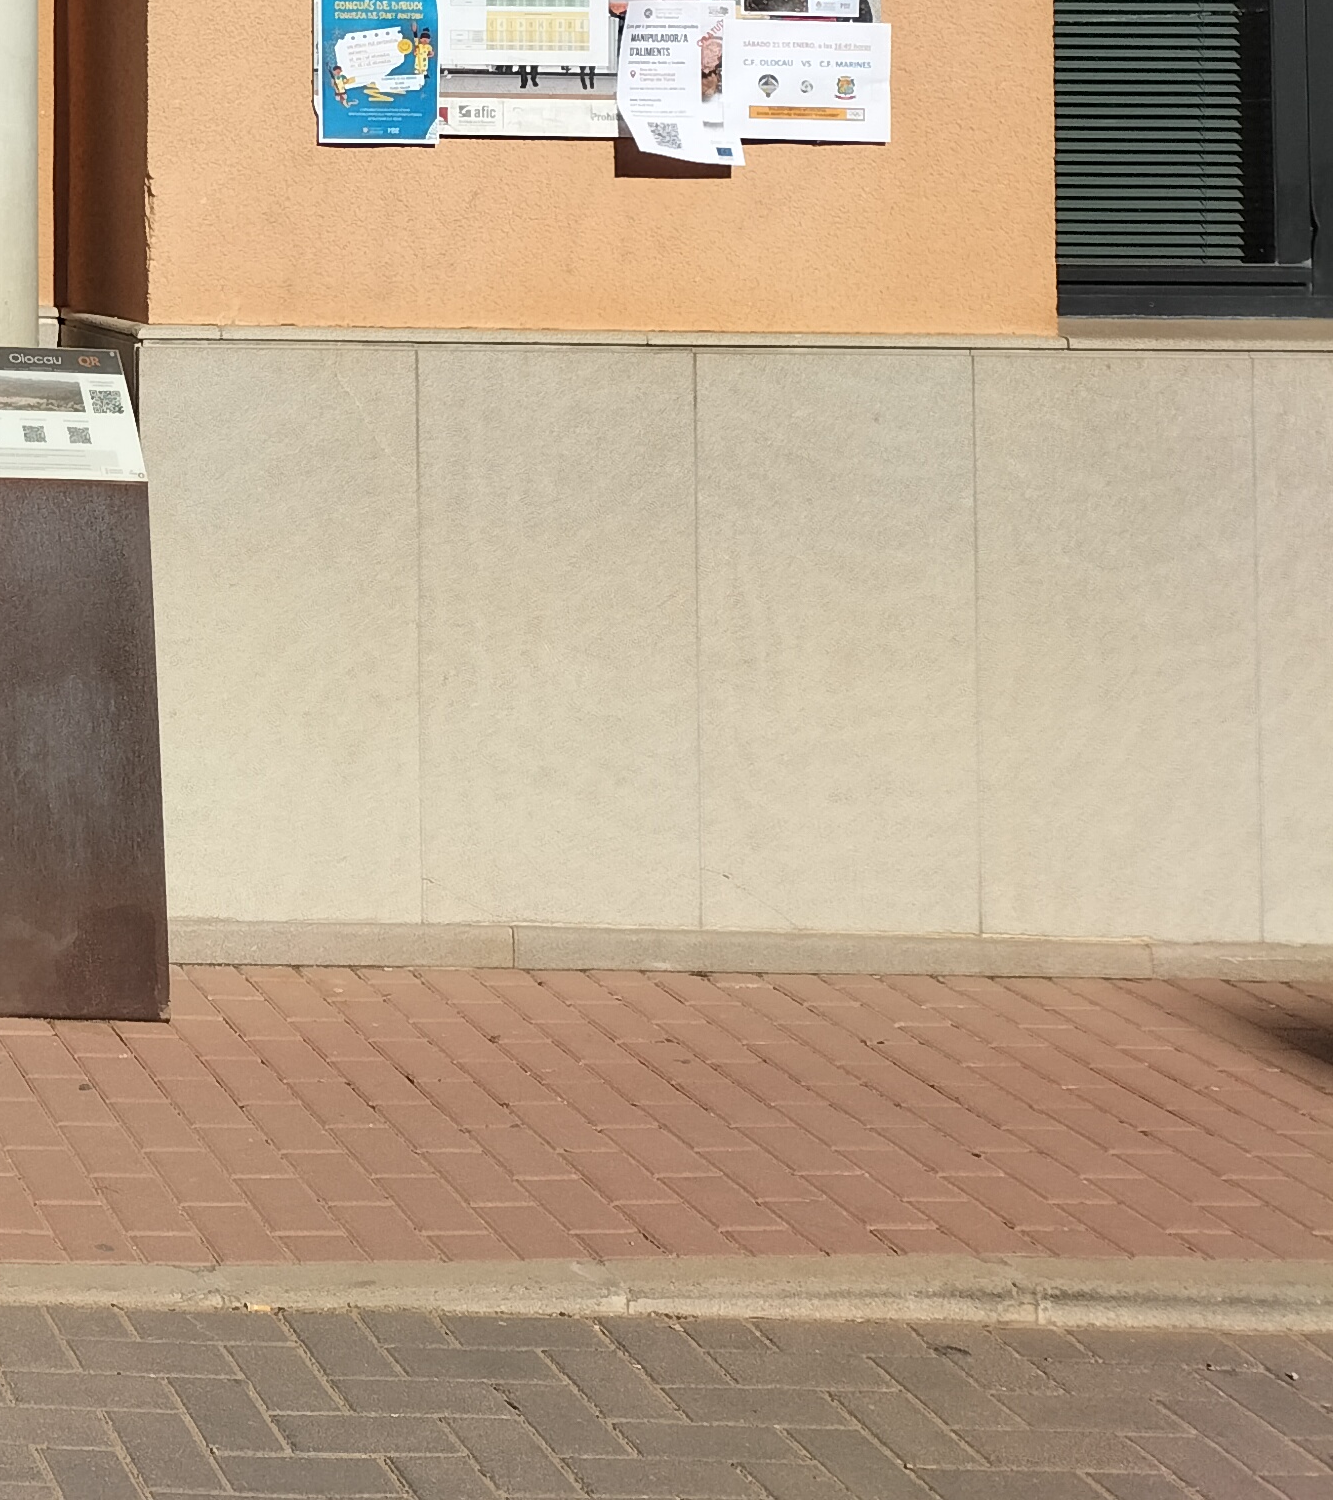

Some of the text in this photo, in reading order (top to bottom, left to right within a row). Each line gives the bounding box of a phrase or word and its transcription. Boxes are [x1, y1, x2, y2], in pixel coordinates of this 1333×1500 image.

[335, 0, 375, 10] CONCURS
[377, 1, 390, 10] DE
[631, 33, 688, 43] MANIPULADOR/A
[743, 40, 771, 48] SÁBADO
[630, 47, 670, 56] D'ALIMENTS
[760, 59, 793, 67] OLOCAU
[801, 60, 812, 68] VS
[836, 61, 872, 69] MARINES
[474, 105, 496, 118] afic
[9, 353, 101, 368] Olocau QR
